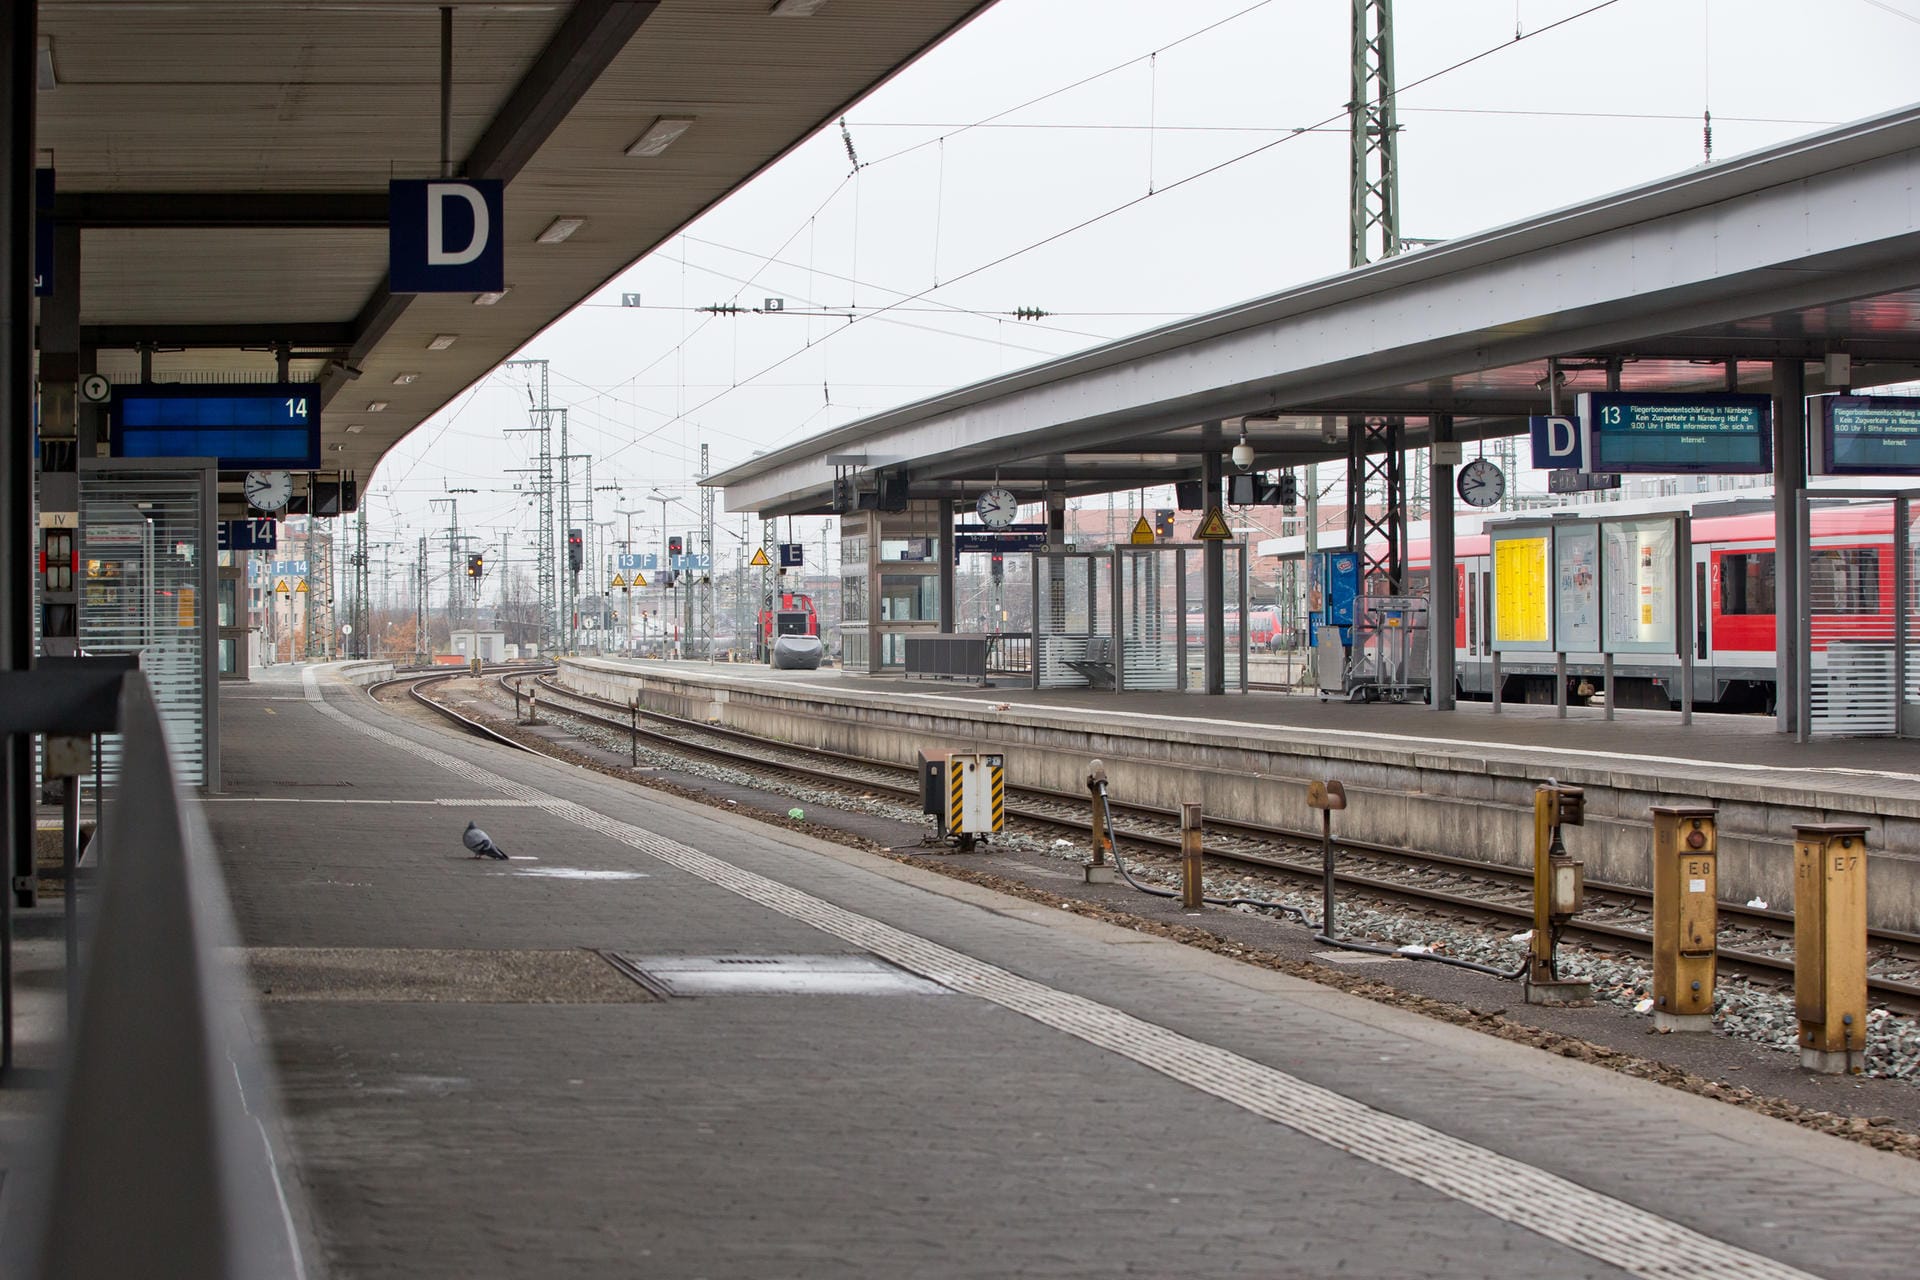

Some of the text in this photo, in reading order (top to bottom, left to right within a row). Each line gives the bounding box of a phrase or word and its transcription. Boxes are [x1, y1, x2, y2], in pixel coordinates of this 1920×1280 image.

[427, 183, 490, 266] D
[285, 398, 308, 418] 14
[1601, 406, 1621, 424] 13
[1652, 415, 1687, 423] Zugverkehr
[1698, 415, 1725, 423] Nürnberg
[1547, 418, 1576, 457] D
[54, 514, 65, 525] IV
[246, 521, 273, 544] 14
[620, 554, 652, 566] 13 F
[678, 554, 710, 566] F 12
[789, 544, 801, 562] E
[276, 561, 308, 572] F 14
[1713, 564, 1719, 582] 2
